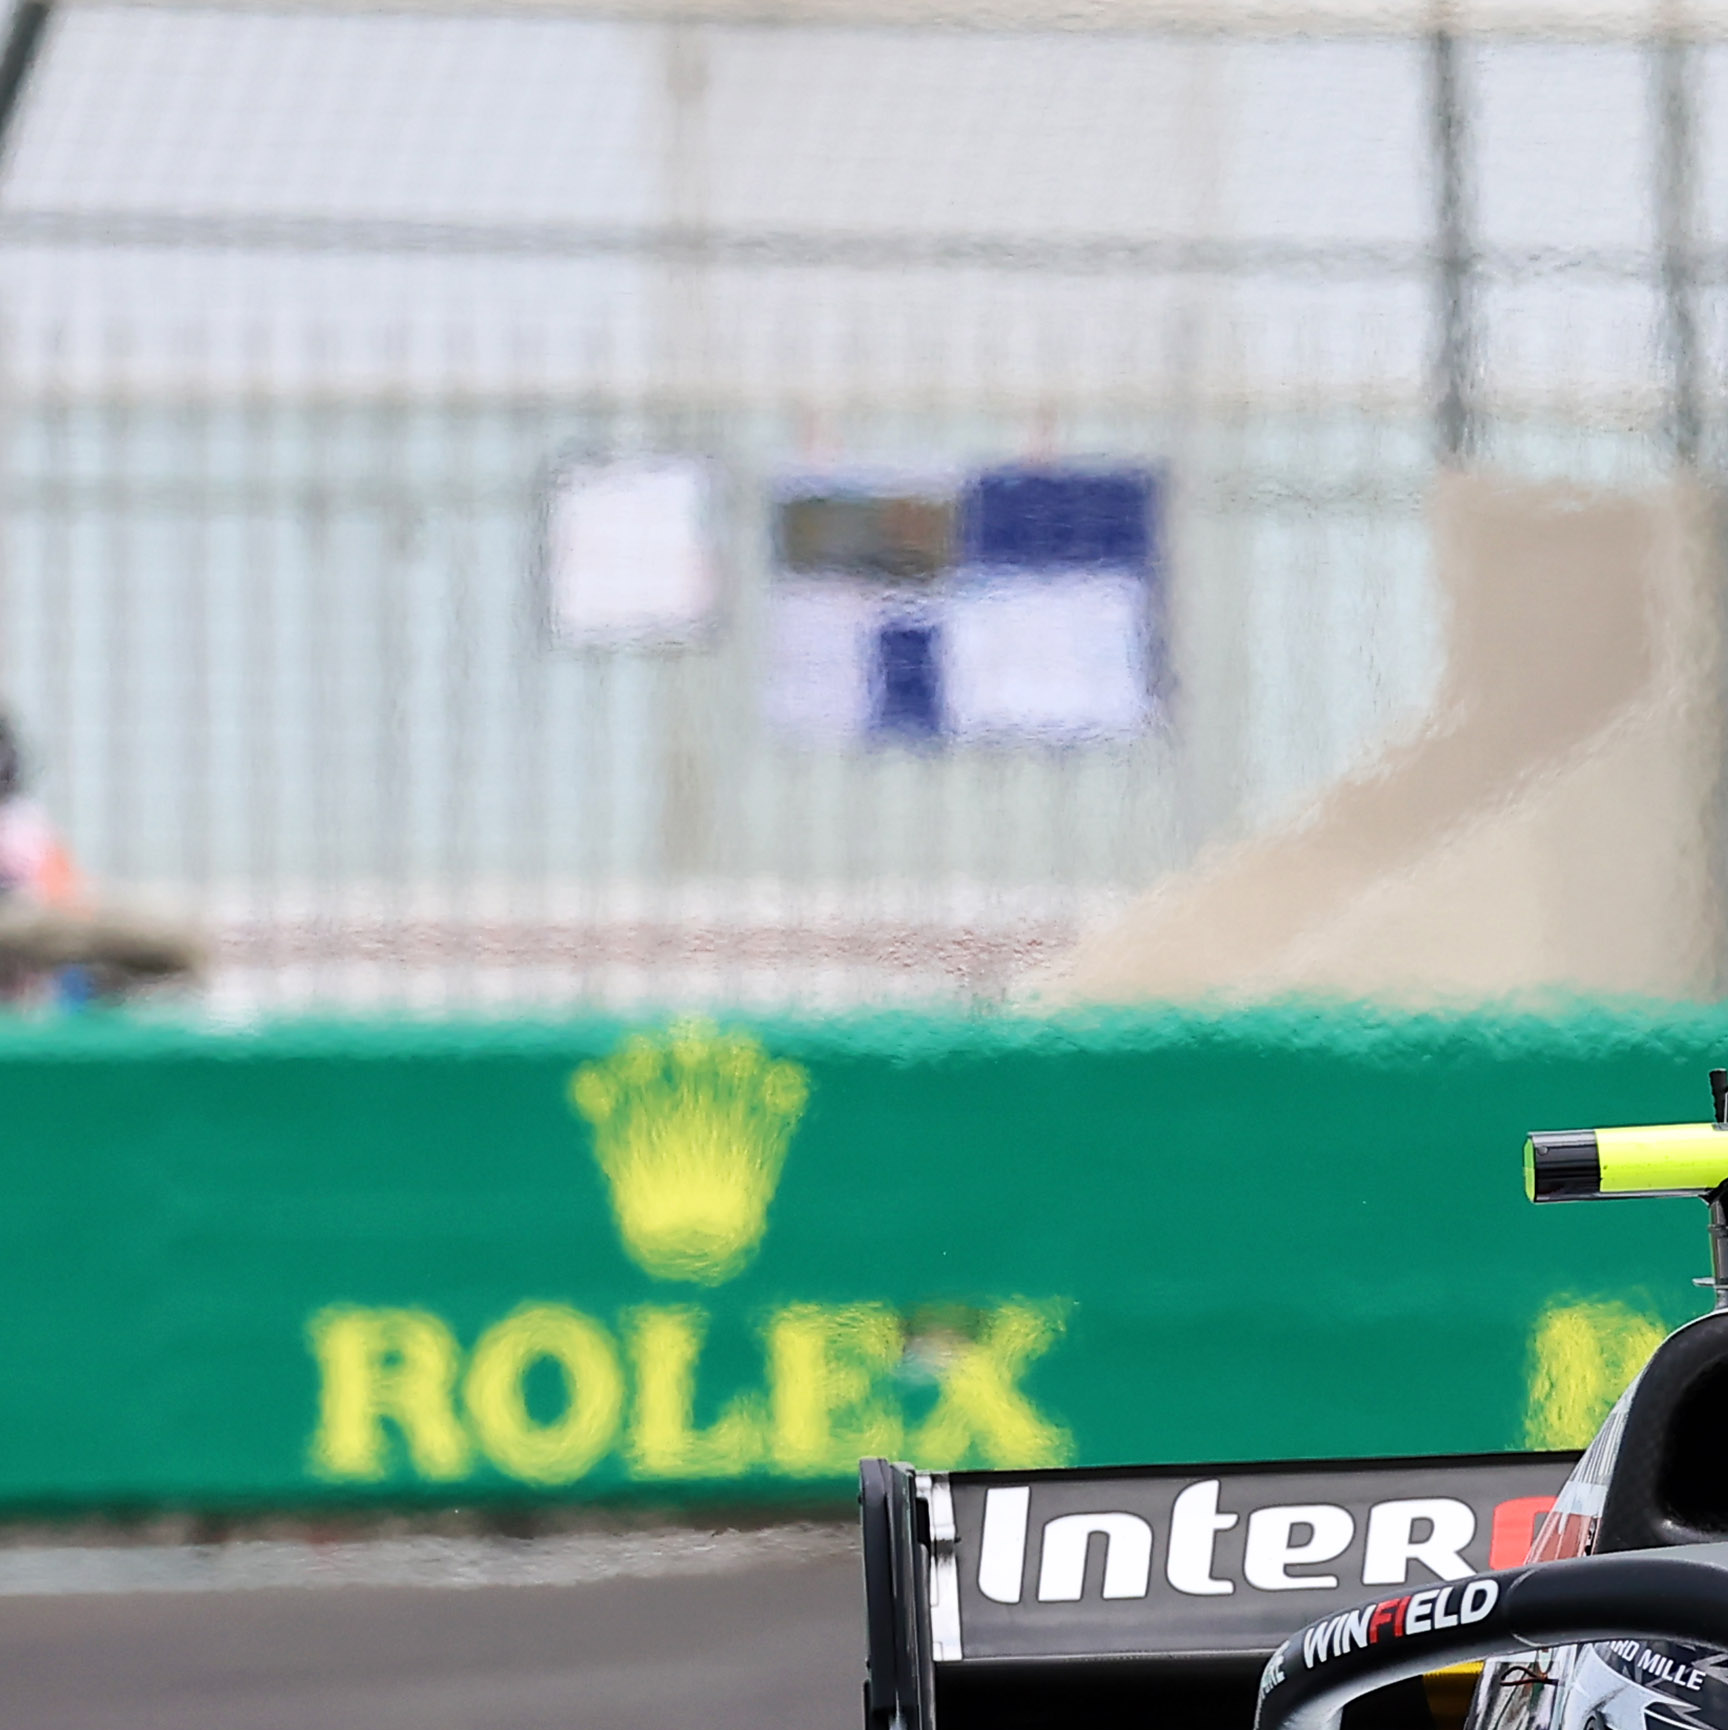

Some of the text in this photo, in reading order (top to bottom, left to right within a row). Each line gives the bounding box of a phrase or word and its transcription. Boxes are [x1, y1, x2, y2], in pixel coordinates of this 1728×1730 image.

[306, 1298, 1076, 1485] ROLEX
[1303, 1579, 1499, 1669] WINFIELD
[1638, 1649, 1706, 1691] MILLE
